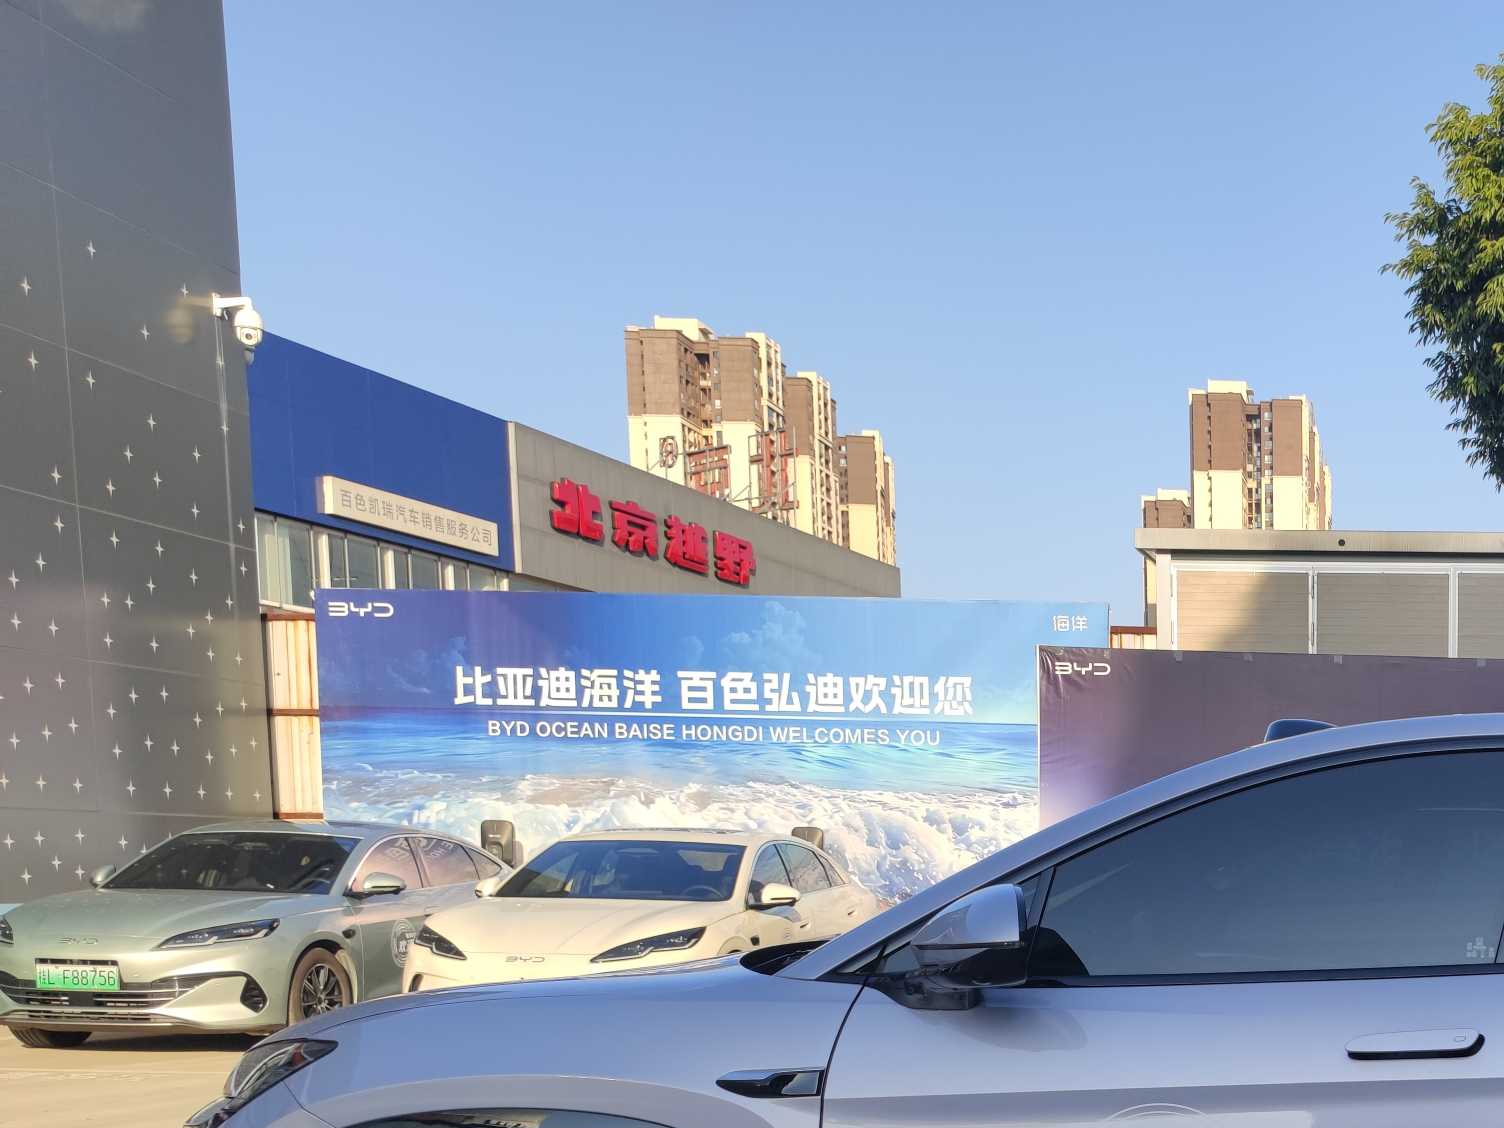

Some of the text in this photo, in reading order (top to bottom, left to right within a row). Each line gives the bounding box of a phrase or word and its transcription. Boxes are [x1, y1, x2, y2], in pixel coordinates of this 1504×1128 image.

[340, 488, 493, 546] 百色凯瑞汽车销售服务公司
[550, 478, 756, 588] 北京越野
[328, 602, 394, 618] BYD
[1053, 615, 1088, 632] 海洋
[1055, 661, 1111, 676] BYD
[453, 665, 974, 716] 比亚迪海洋 百色弘迪欢迎您
[487, 720, 941, 747] BYD OCEAN BAISE HONGDI WELCOMES YOU
[505, 955, 546, 963] BYD
